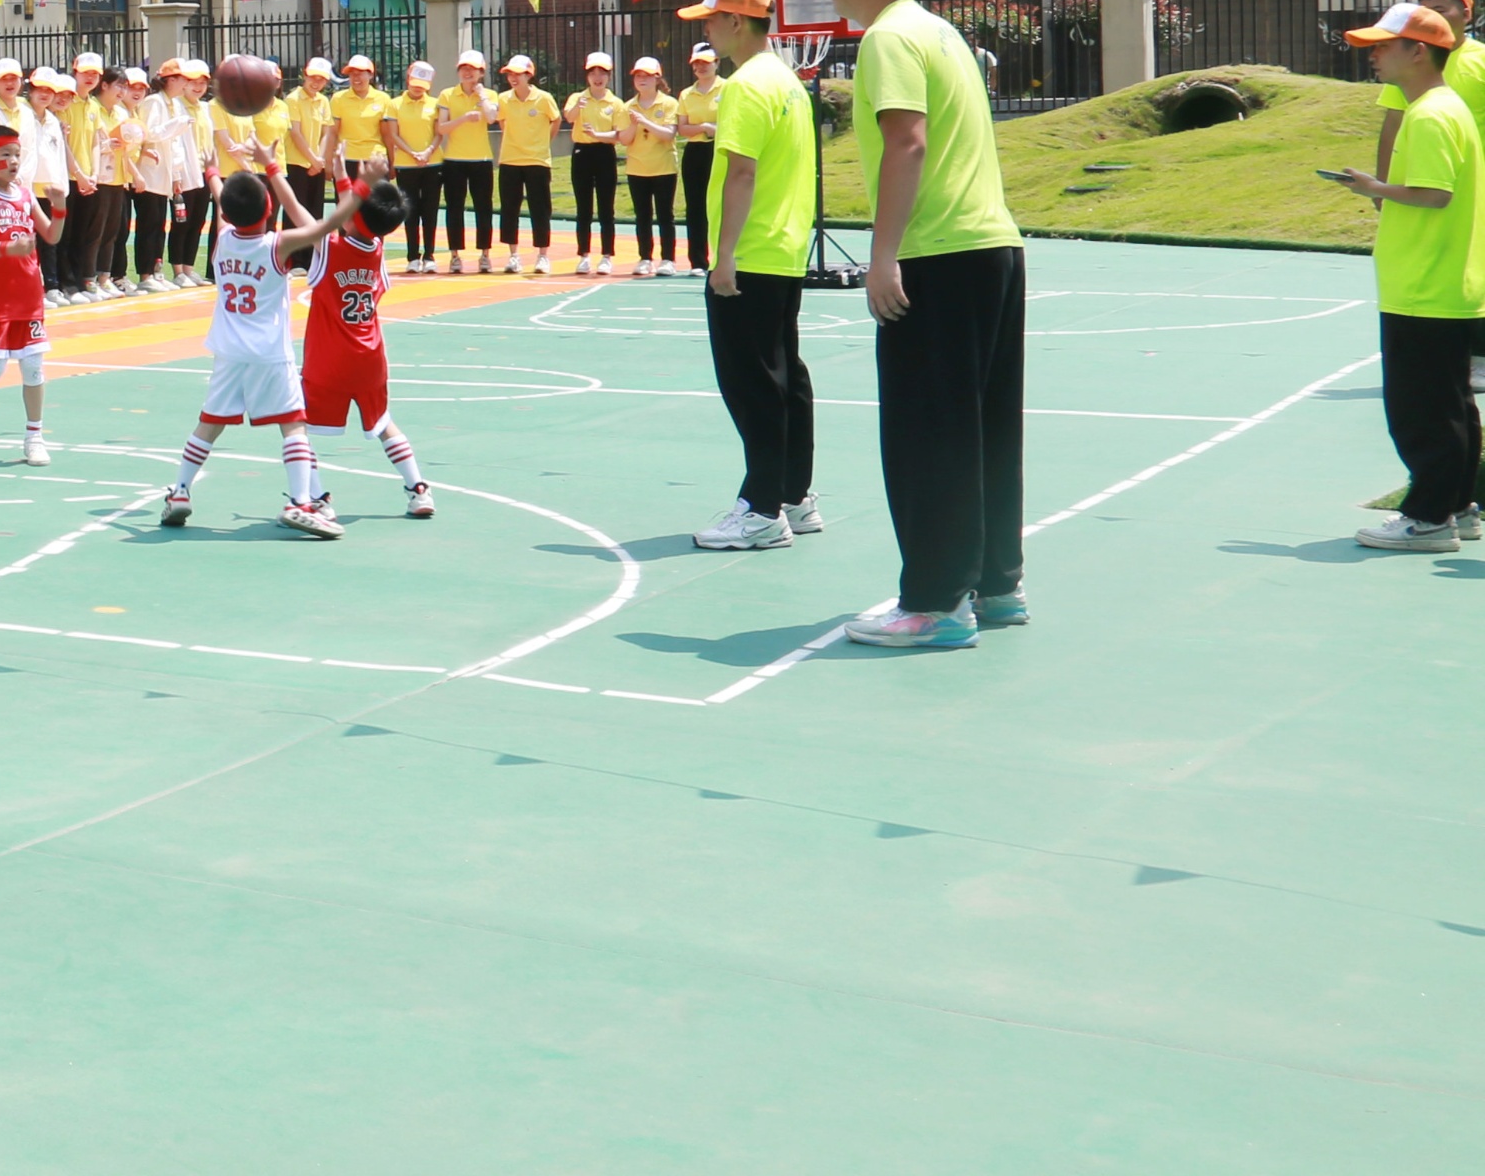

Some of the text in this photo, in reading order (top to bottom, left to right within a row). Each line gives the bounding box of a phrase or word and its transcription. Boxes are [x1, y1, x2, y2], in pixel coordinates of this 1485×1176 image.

[219, 258, 266, 281] DSKLR
[223, 283, 256, 315] 23
[341, 290, 374, 324] 23
